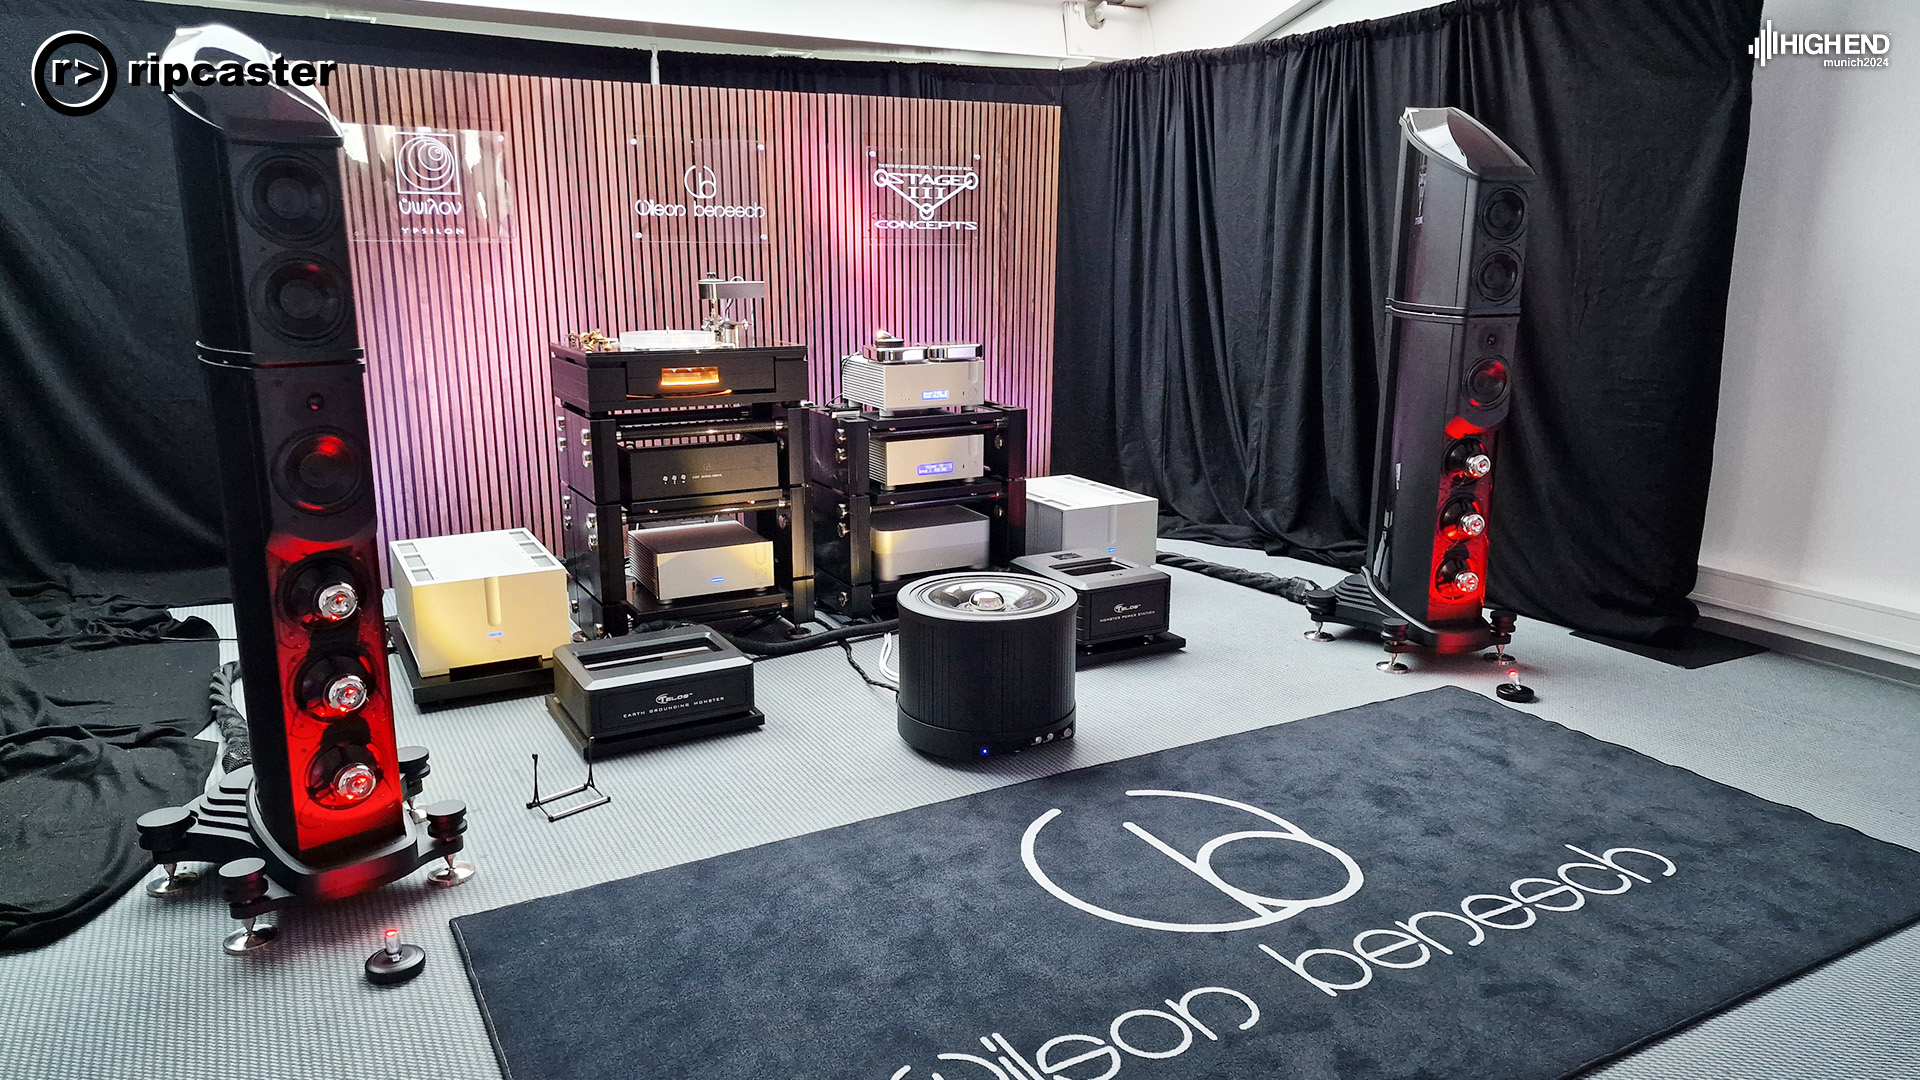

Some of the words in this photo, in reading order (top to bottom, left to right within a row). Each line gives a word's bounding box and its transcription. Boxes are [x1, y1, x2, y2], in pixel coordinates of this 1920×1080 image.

[887, 172, 966, 186] STAGE
[908, 186, 947, 199] III
[693, 200, 766, 218] benesch
[401, 227, 465, 235] YPSILON
[874, 219, 978, 231] CONCEPTS
[623, 710, 646, 719] EARTH
[648, 702, 690, 714] GROUNDING
[693, 696, 725, 706] MONSTER
[1257, 843, 1677, 997] benesch
